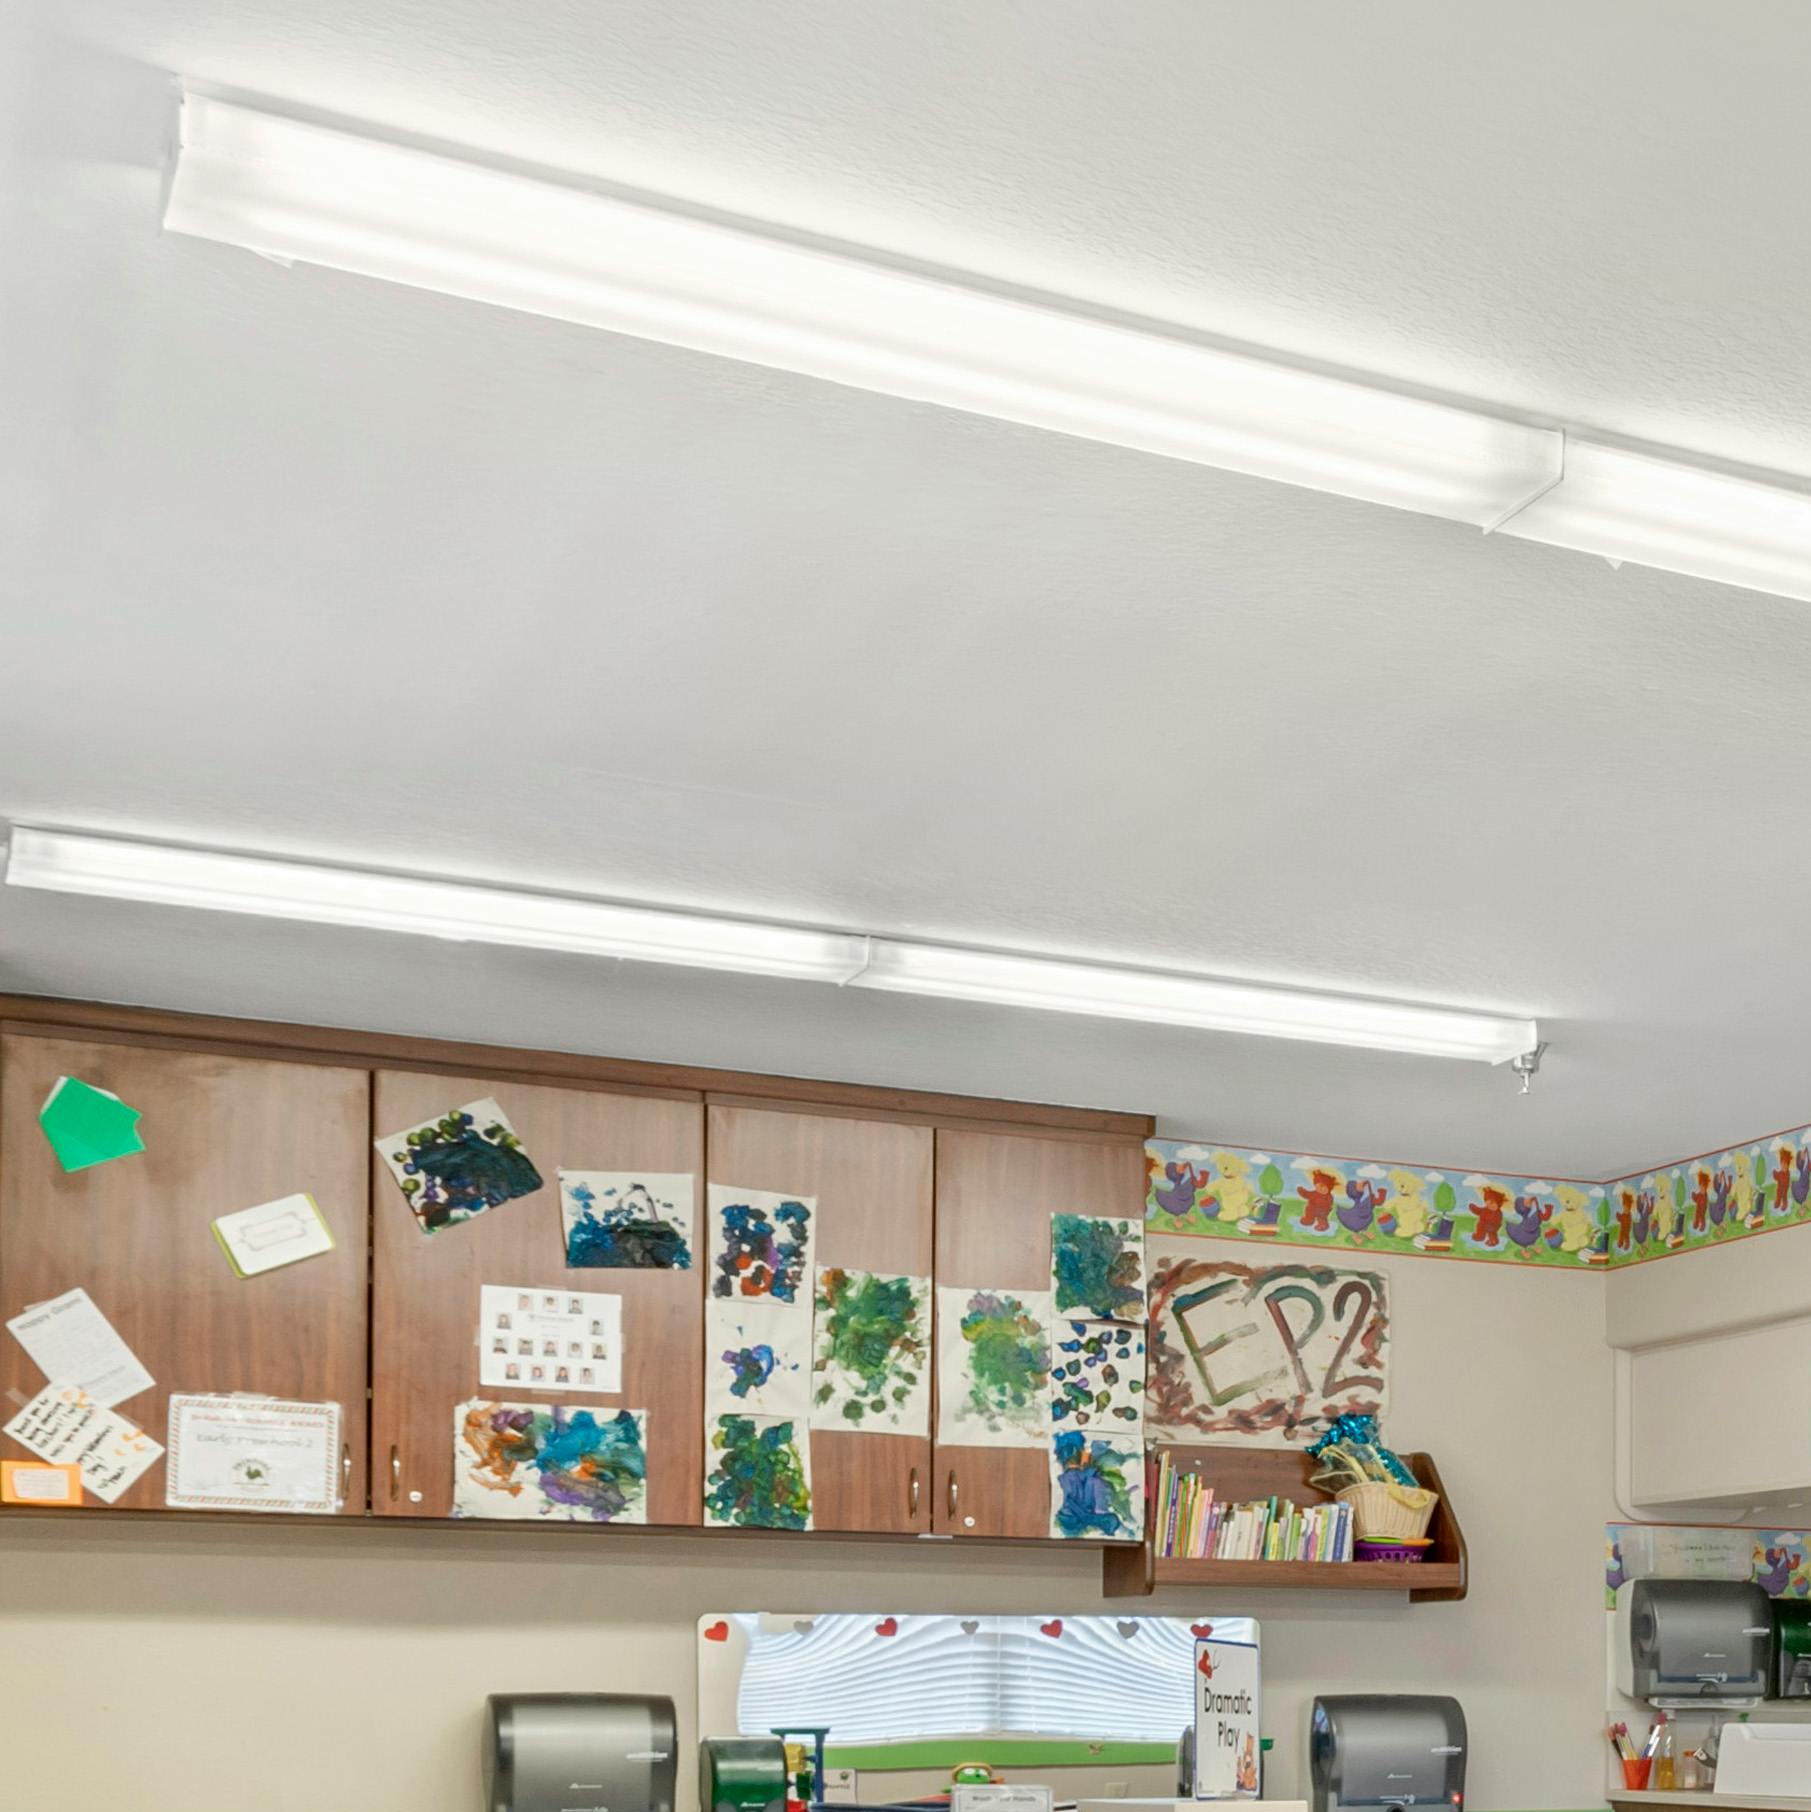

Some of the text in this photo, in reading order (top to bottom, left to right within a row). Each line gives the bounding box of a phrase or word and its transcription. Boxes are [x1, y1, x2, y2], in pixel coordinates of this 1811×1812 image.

[1172, 1279, 1385, 1406] EP2
[1204, 1687, 1252, 1715] Dramatic
[1218, 1721, 1241, 1753] Play
